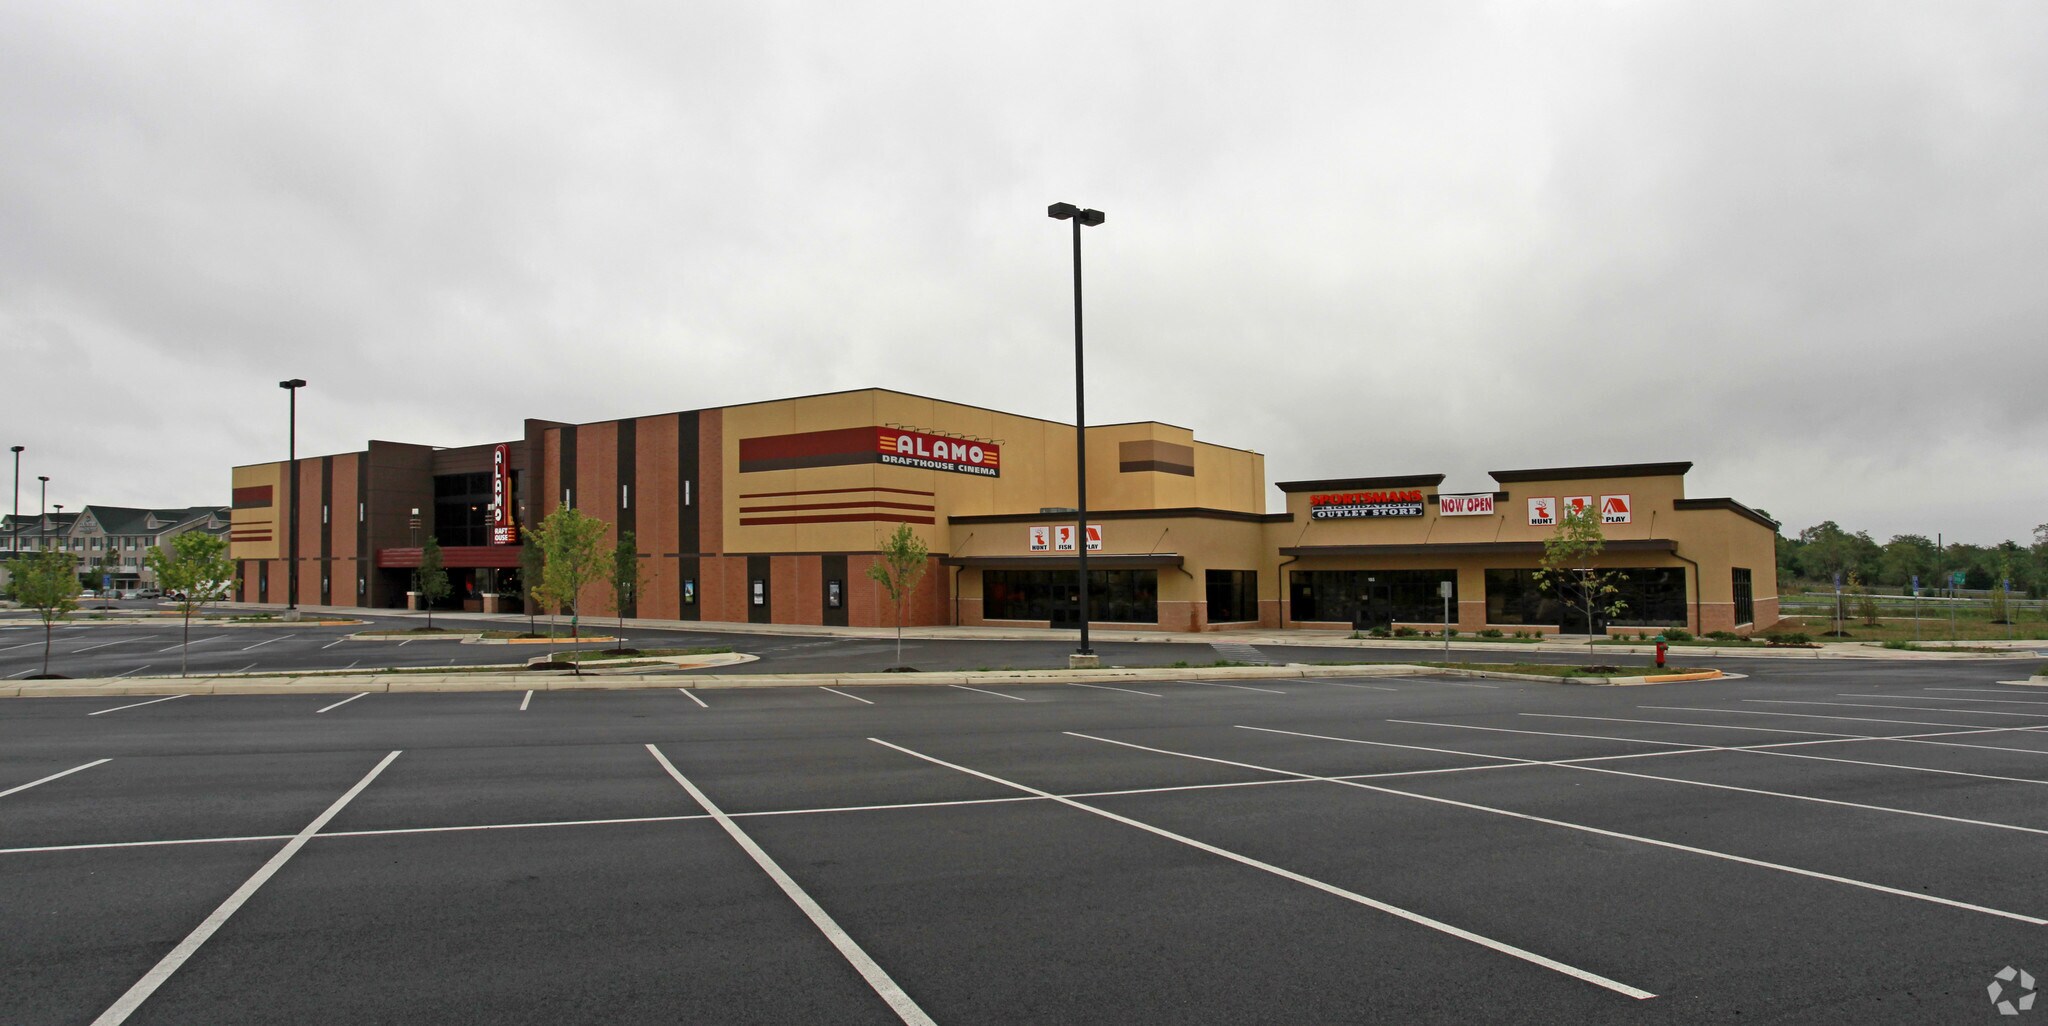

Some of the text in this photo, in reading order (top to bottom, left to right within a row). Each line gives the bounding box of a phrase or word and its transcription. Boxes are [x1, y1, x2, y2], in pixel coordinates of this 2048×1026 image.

[897, 435, 983, 463] ALAMO
[882, 455, 996, 476] DRAFTHOUSE CINEMA
[1309, 490, 1423, 506] SPORTSMANS
[1441, 497, 1492, 513] NOW OPEN
[1317, 508, 1417, 518] OUTLET STORE
[494, 527, 508, 535] RAFT
